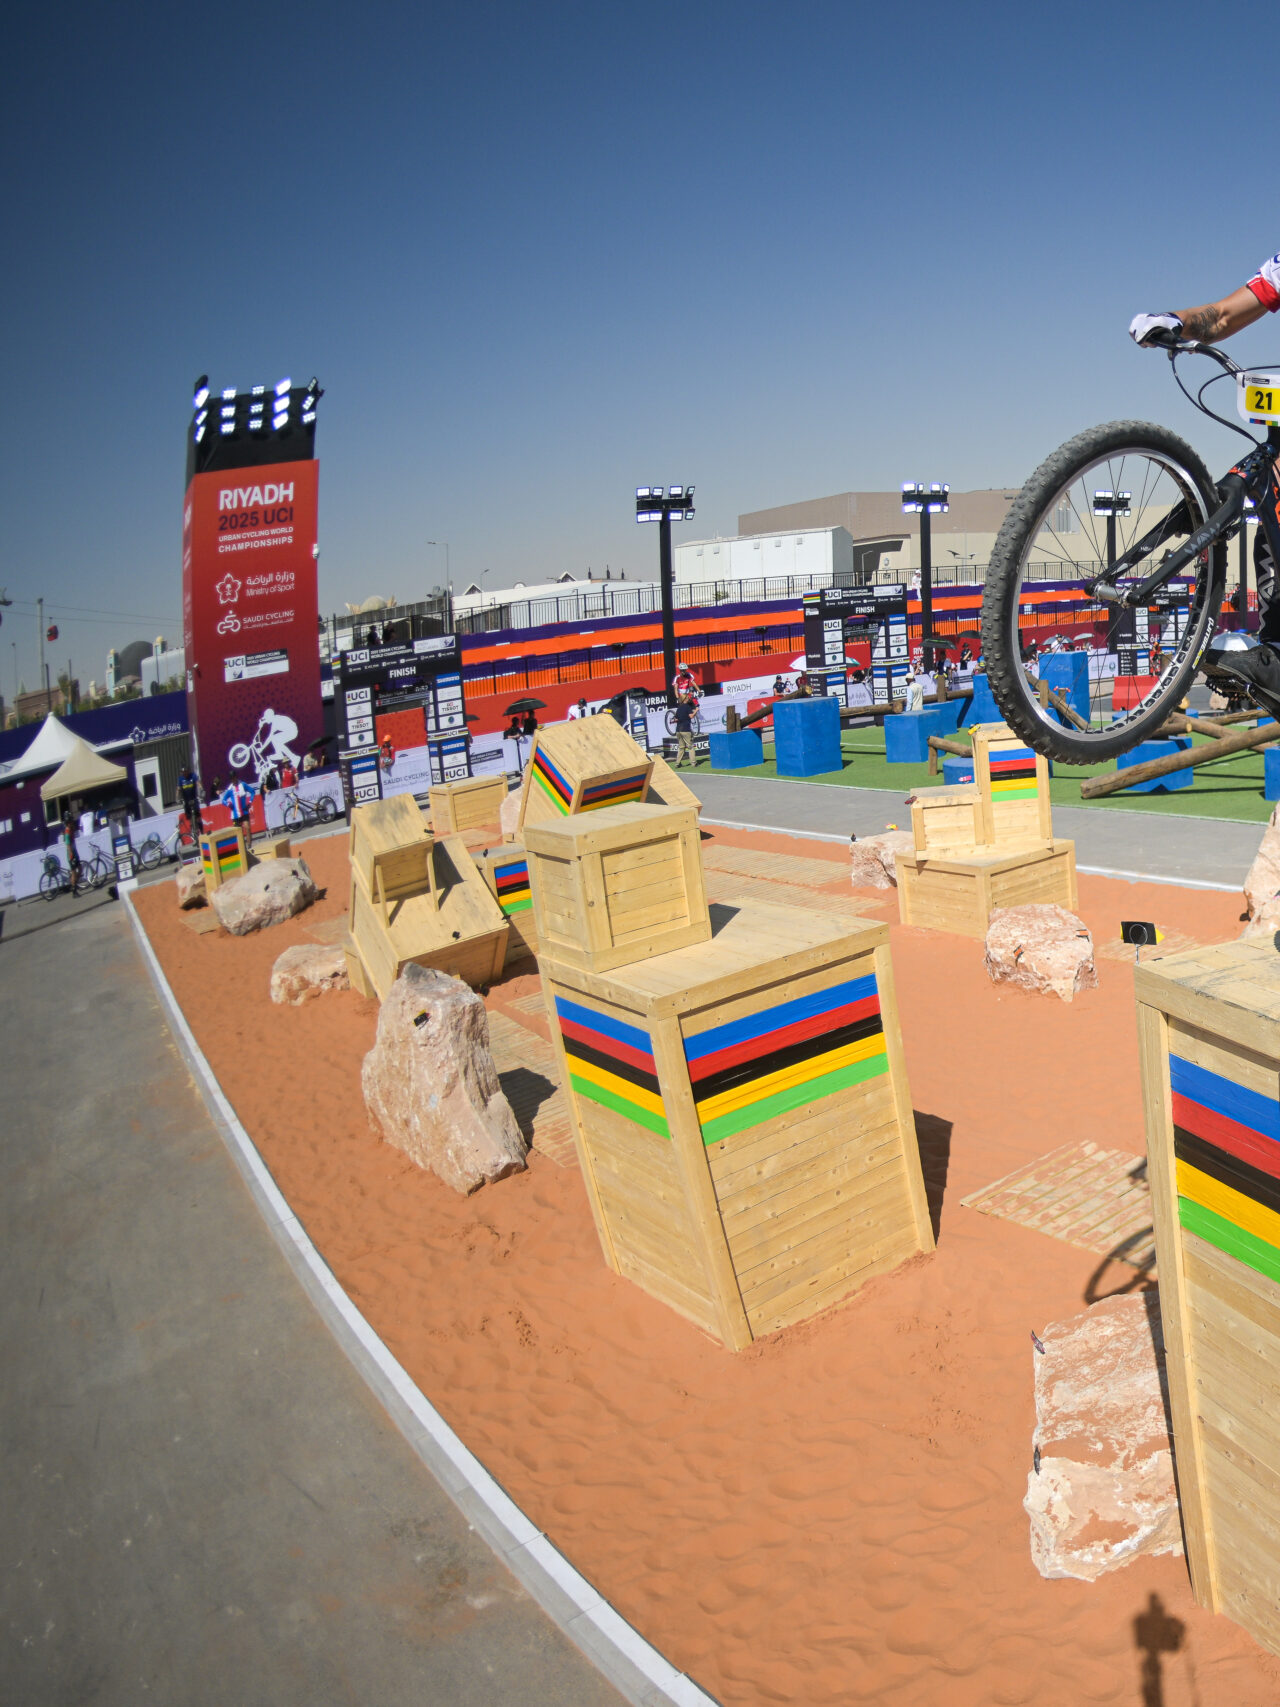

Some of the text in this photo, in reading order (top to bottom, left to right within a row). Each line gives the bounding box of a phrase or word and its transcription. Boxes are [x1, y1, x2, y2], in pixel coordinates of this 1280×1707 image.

[1255, 390, 1273, 411] 21
[219, 482, 294, 511] RIYADH
[219, 507, 294, 531] 2025 UCI
[219, 526, 294, 542] URBAN CYCLING WORLD
[218, 536, 293, 553] CHAMPIONSHIPS
[246, 571, 295, 586] وزارة الرياضة
[246, 587, 269, 597] Ministry
[277, 583, 295, 593] Sport
[855, 606, 875, 614] FINISH
[243, 615, 264, 624] SAUDI
[265, 610, 295, 620] CYCLING
[228, 657, 245, 668] UCI
[350, 652, 368, 662] UCI
[389, 666, 417, 678] FINISH
[726, 683, 752, 693] RIYADH
[351, 690, 368, 701] UCI
[633, 704, 642, 717] 2
[383, 771, 430, 785] SAUDI CYCLING
[449, 768, 466, 779] UCI
[358, 787, 376, 799] UCI
